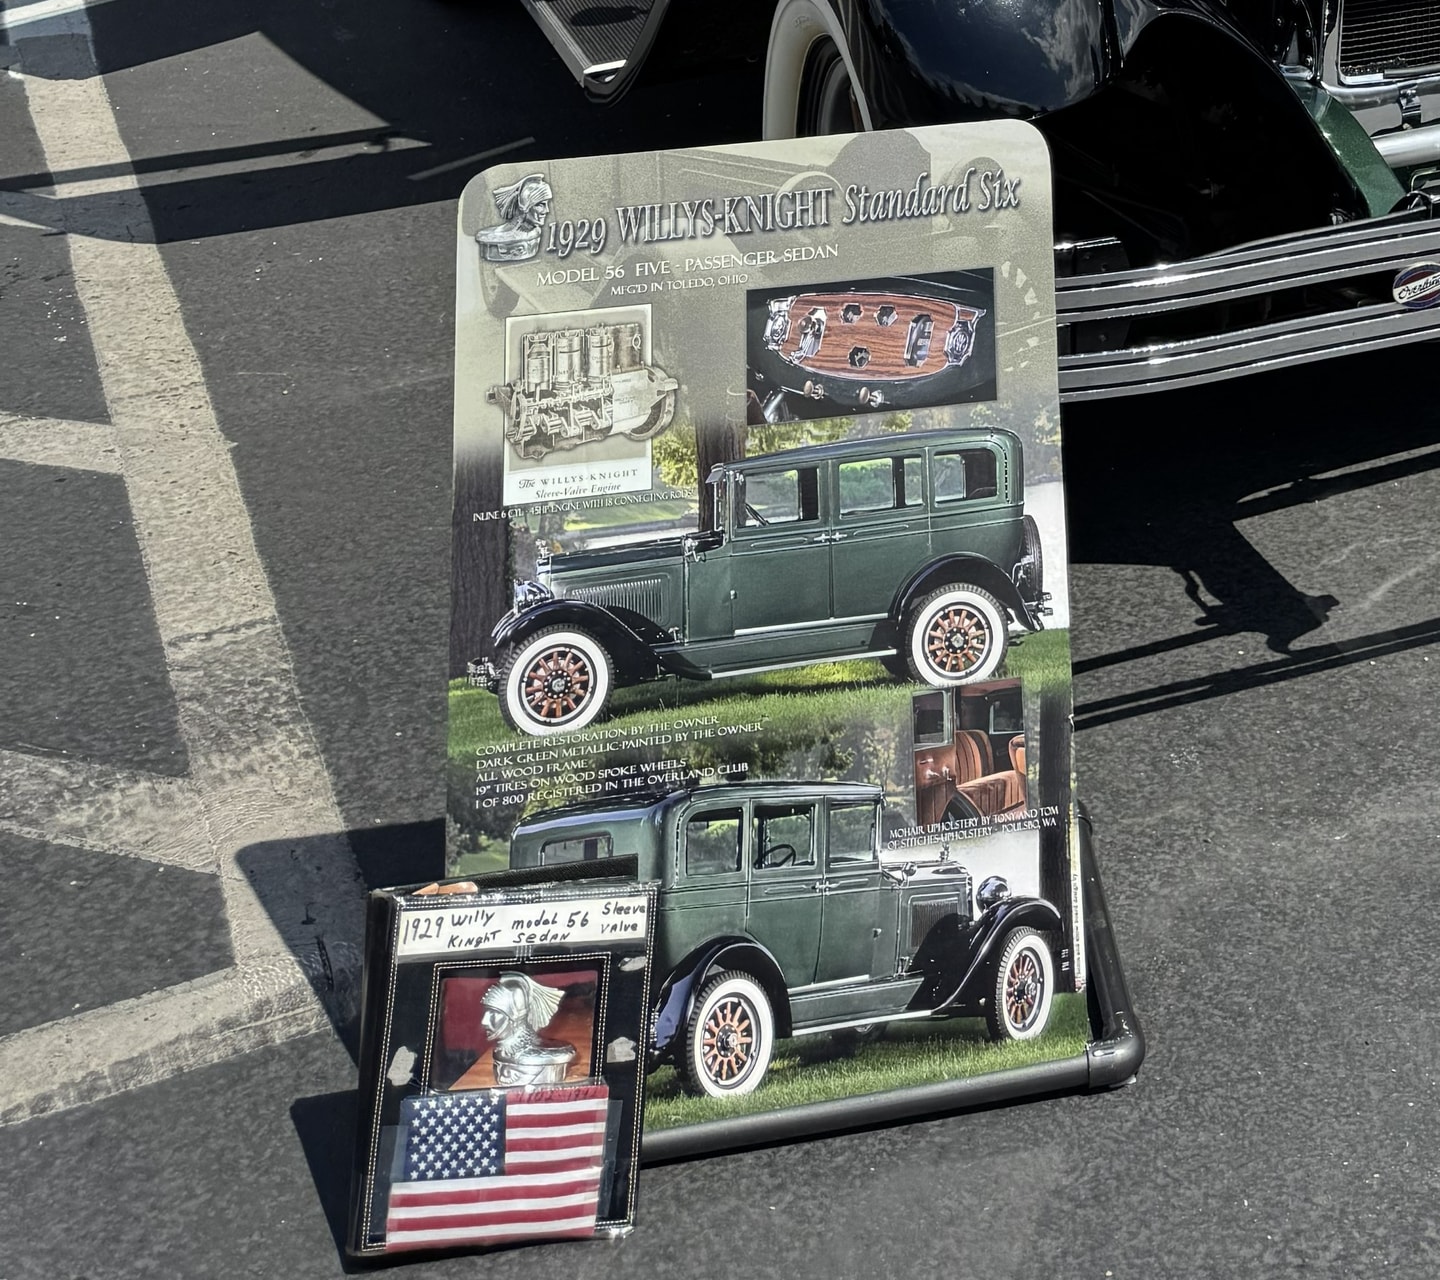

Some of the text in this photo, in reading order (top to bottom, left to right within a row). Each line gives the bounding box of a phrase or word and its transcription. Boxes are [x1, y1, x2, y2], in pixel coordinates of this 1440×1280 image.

[546, 167, 1021, 257] 1929 WILLYS-KNIGHT Standard Six
[536, 267, 600, 287] MODEL
[603, 265, 625, 280] 56
[635, 260, 671, 277] FIVE
[685, 251, 776, 272] PASSENGER
[783, 244, 839, 262] SEDAN
[610, 273, 749, 296] MFG'D IN TOLEDO, OHIO
[518, 478, 536, 489] The
[591, 482, 622, 495] Engine
[473, 510, 500, 522] INLINE
[501, 511, 507, 519] 6
[551, 502, 581, 513] ENGINE
[582, 498, 604, 509] WITH
[605, 497, 613, 507] 18
[614, 492, 669, 506] CONNECTING
[475, 715, 720, 757] COMPLETE RESTORATION BY THE OWNER
[476, 755, 514, 770] DARK
[516, 750, 559, 764] GREEN
[675, 731, 690, 742] BY
[692, 728, 716, 740] THE
[717, 722, 764, 736] OWNER
[475, 759, 588, 783] ALL WOOD FRAME
[482, 797, 500, 808] OF
[502, 793, 525, 806] 800
[527, 782, 602, 801] REGISTERED
[605, 780, 619, 791] IN
[621, 776, 645, 789] THE
[647, 767, 715, 785] OVERLAND
[717, 762, 749, 775] CLUB
[494, 780, 528, 793] TIRES
[530, 777, 551, 788] ON
[553, 771, 596, 785] WOOD
[598, 764, 638, 779] SPOKE
[640, 757, 689, 774] WHEELS
[887, 840, 898, 850] OF
[1001, 819, 1041, 833] POULSBO,
[1041, 817, 1057, 828] WA
[889, 805, 1059, 839] MOHAIR UPHOLSTERY BY TONY AND TOM
[403, 916, 445, 945] 1929
[566, 910, 590, 928] 56
[601, 901, 646, 916] Sleeve
